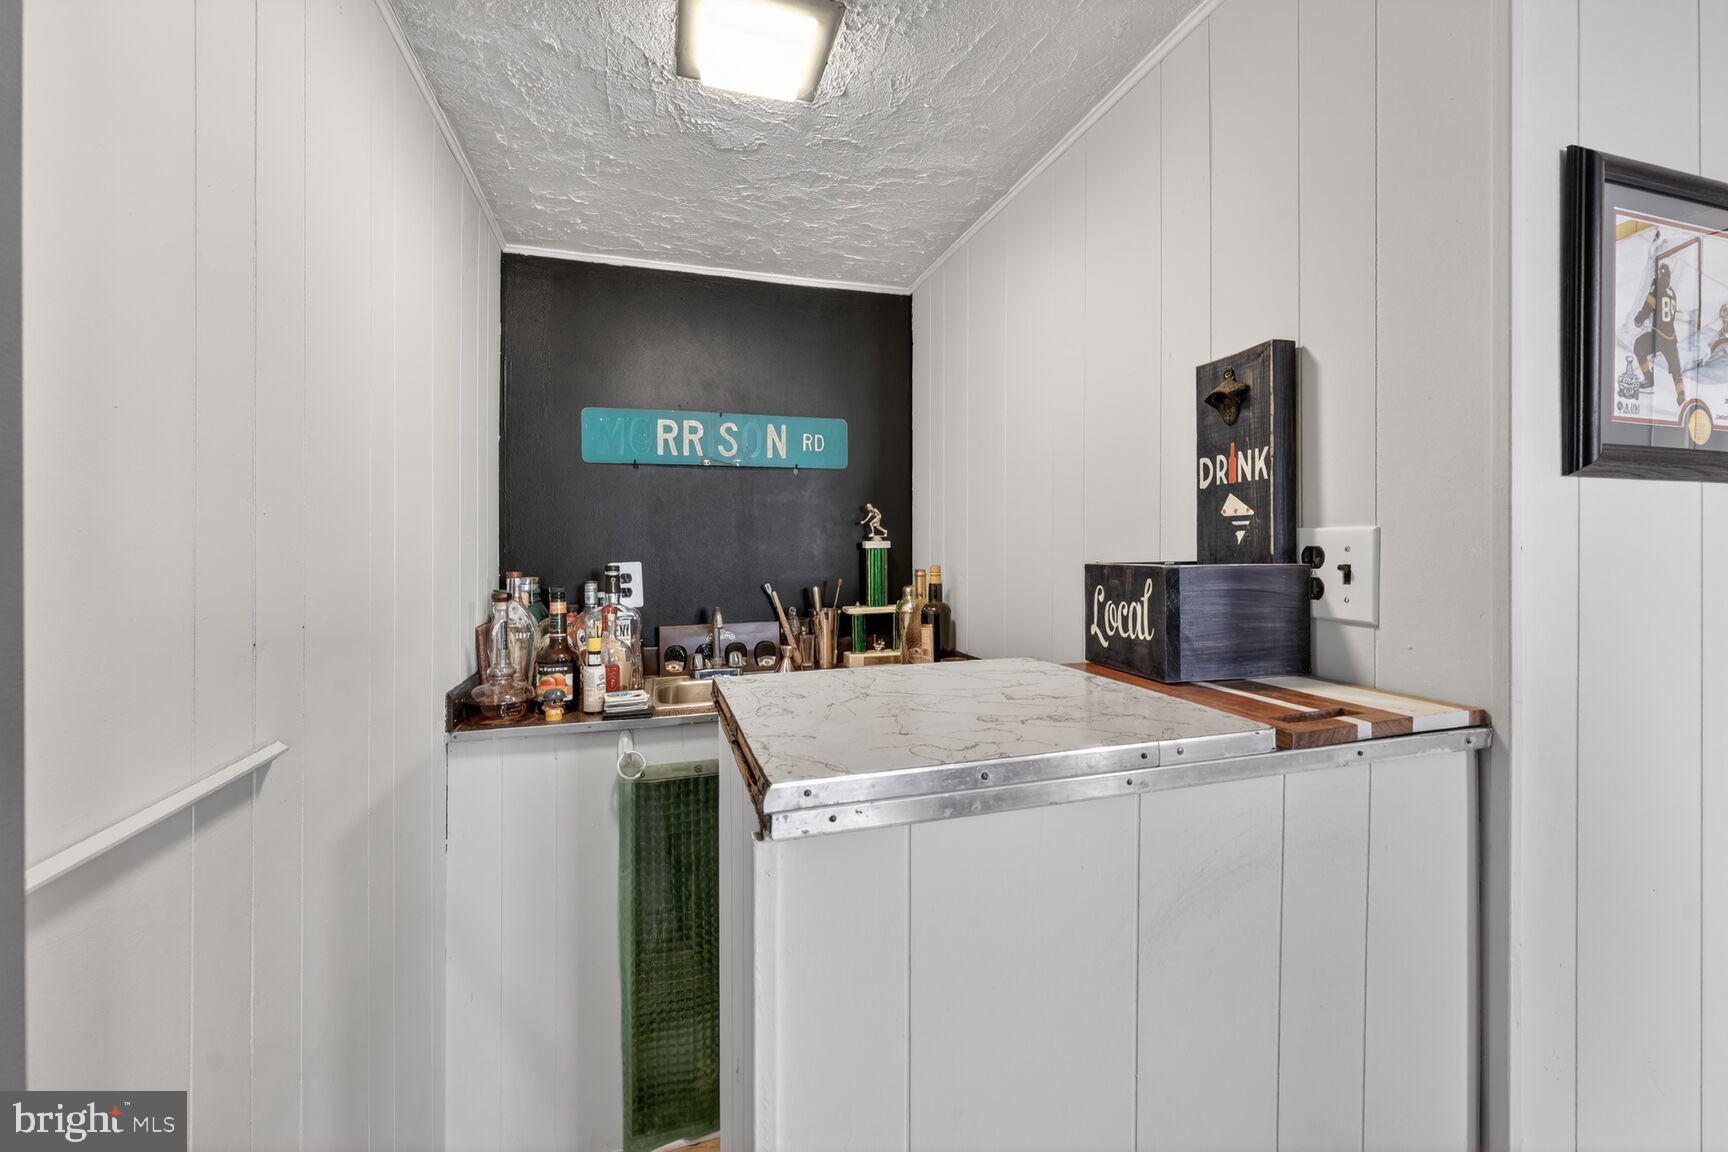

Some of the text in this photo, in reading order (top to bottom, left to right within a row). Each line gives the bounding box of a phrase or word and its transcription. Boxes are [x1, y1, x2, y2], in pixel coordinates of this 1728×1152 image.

[802, 433, 825, 452] RD
[1199, 442, 1269, 489] DRINK
[1090, 578, 1154, 648] Local
